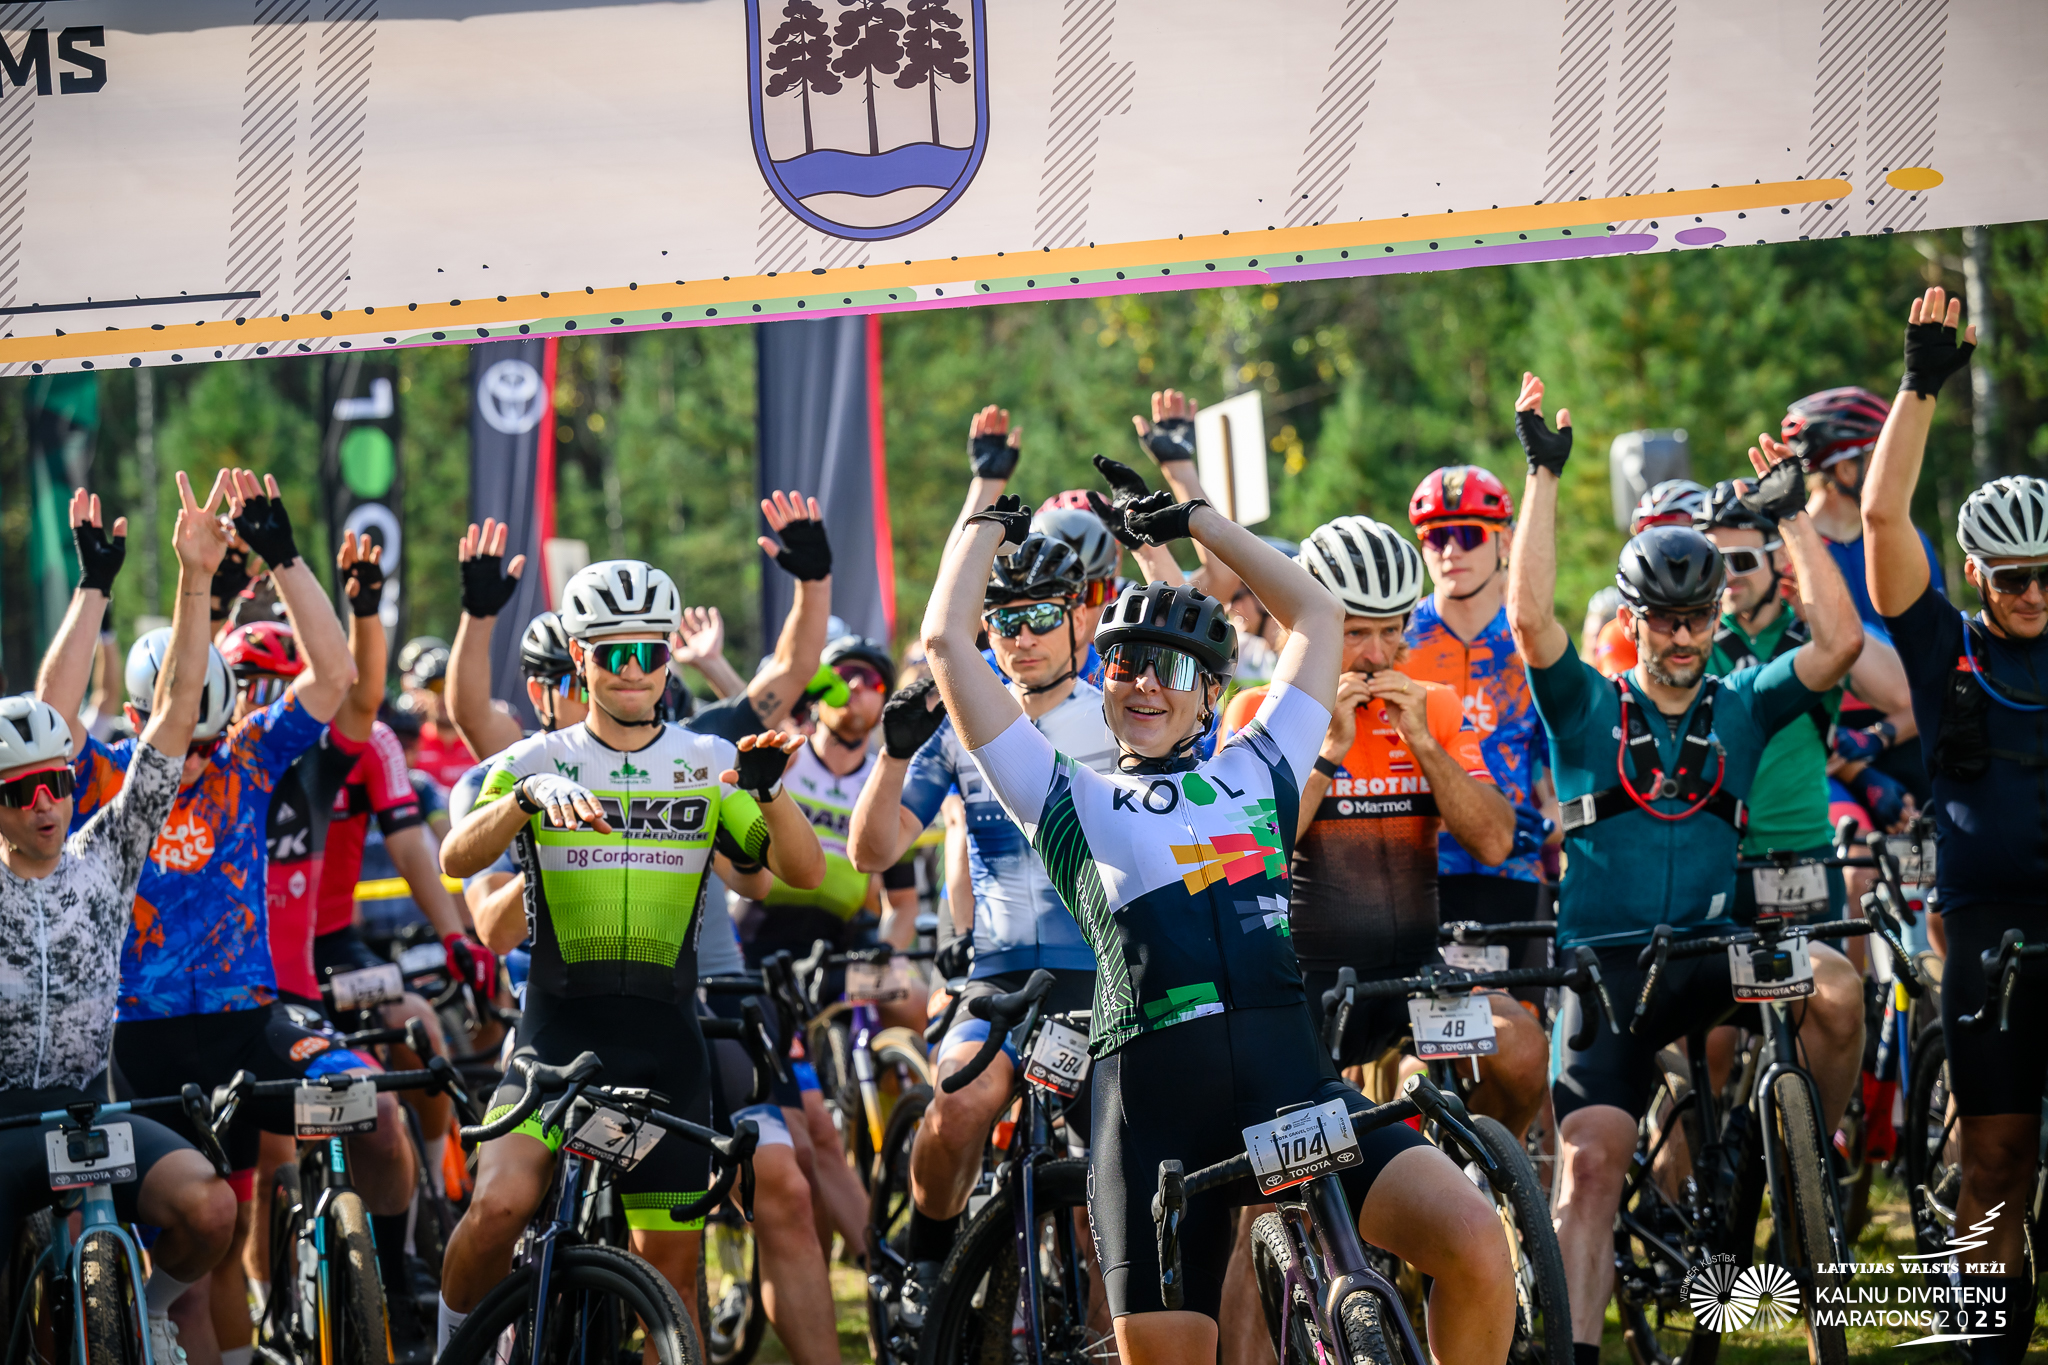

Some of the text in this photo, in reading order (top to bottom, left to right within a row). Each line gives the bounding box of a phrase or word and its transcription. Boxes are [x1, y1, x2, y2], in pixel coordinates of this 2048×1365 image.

[1355, 799, 1412, 814] Marmot
[592, 849, 684, 866] Corporation
[1757, 987, 1791, 997] TOYOTA
[1442, 1020, 1465, 1037] 48
[1440, 1042, 1475, 1052] TOYOTA
[1052, 1052, 1084, 1076] 384
[1270, 1135, 1289, 1144] TYOTA
[587, 1146, 616, 1161] TOYOTA
[1281, 1132, 1324, 1166] 104
[76, 1171, 111, 1182] TOYOTA
[1289, 1160, 1332, 1178] TOYOTA
